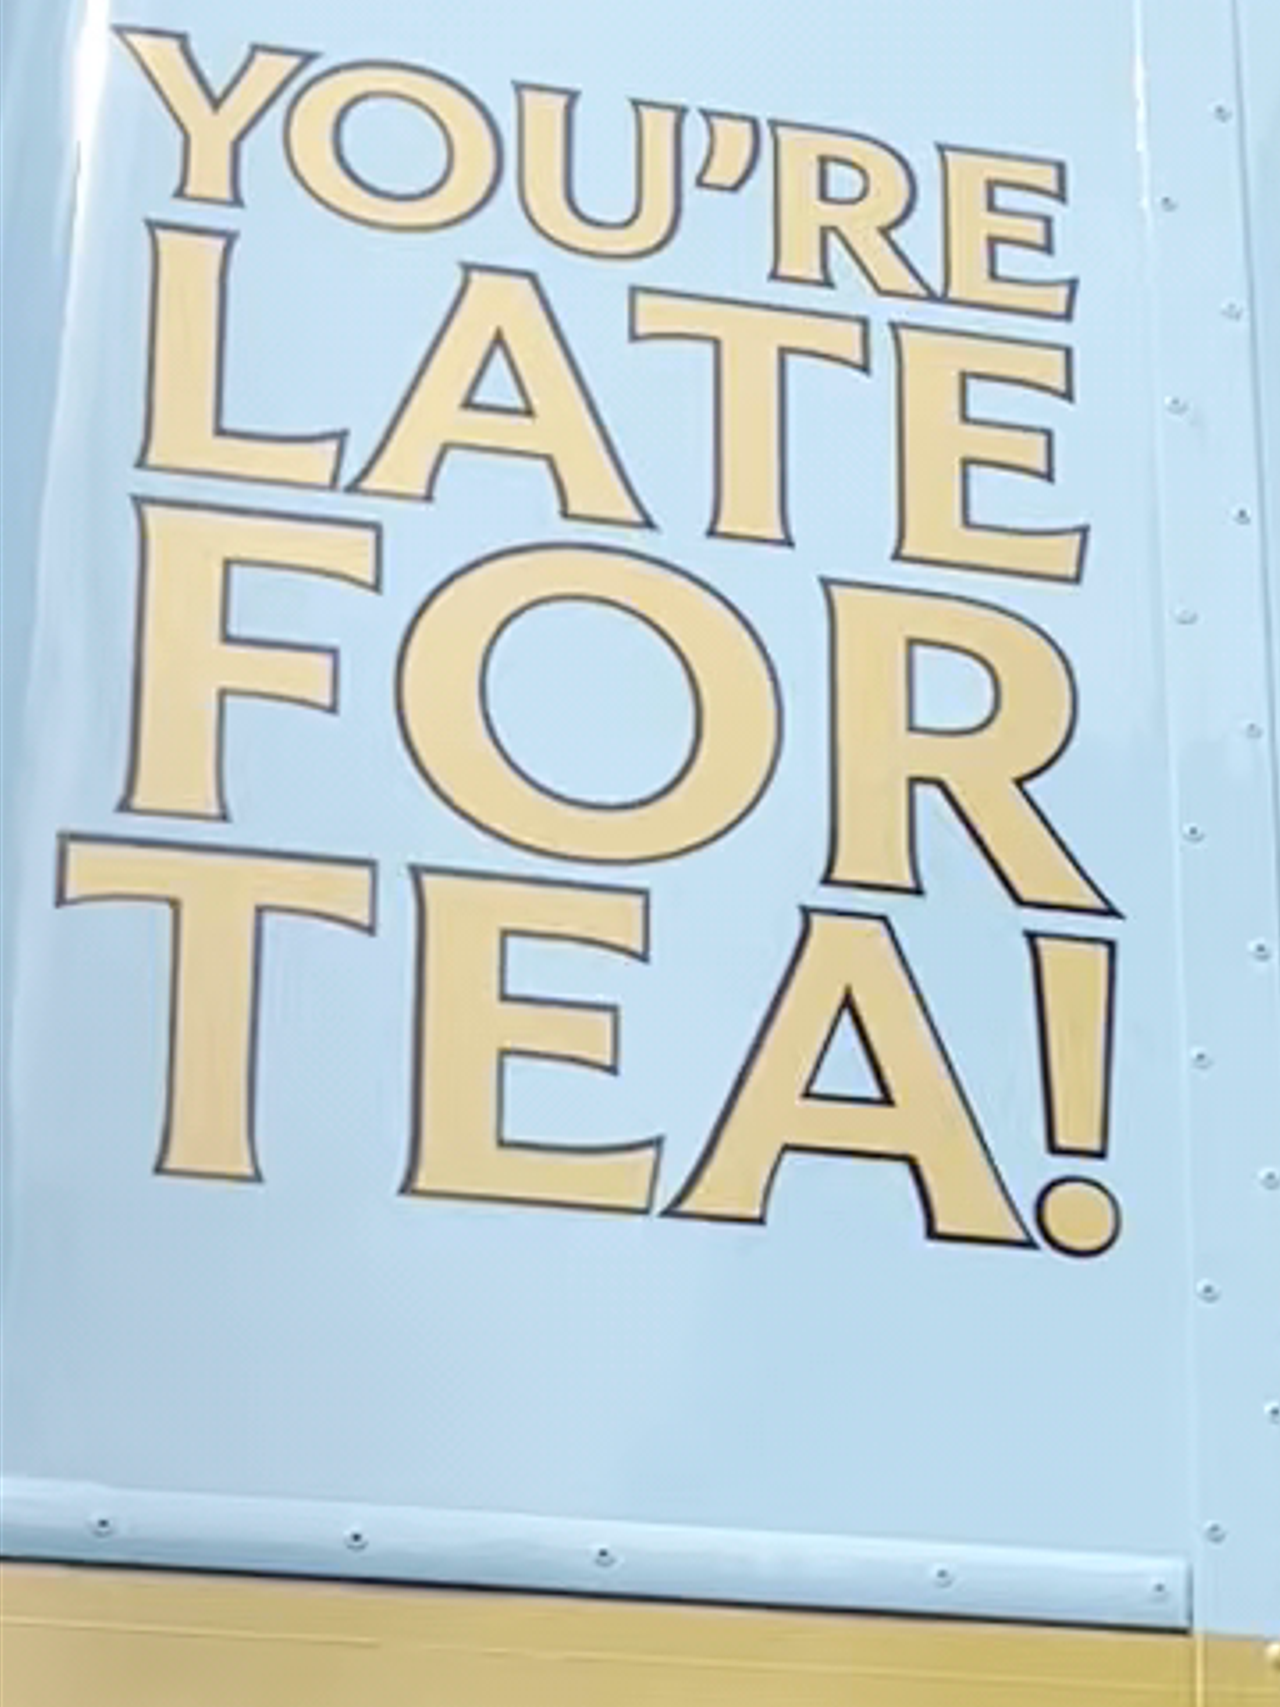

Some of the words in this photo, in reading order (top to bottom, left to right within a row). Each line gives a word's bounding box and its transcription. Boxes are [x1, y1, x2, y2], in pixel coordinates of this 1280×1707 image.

[113, 24, 1081, 322] YOU'RE
[136, 219, 1090, 584] LATE
[117, 495, 1126, 919] FOR
[55, 831, 1124, 1258] TEA!
